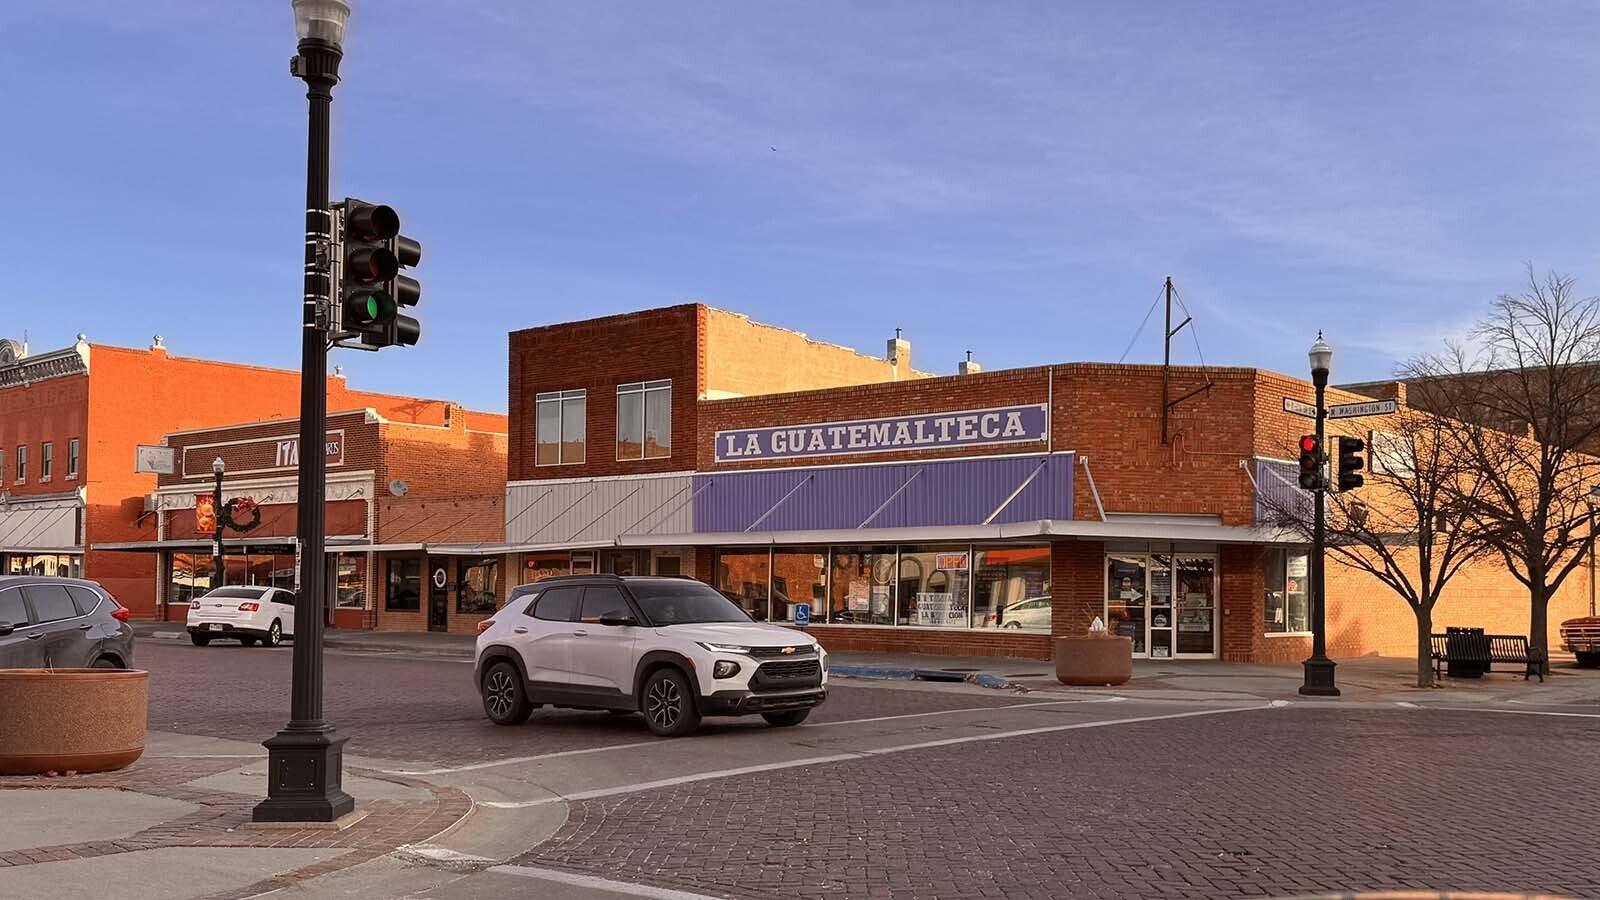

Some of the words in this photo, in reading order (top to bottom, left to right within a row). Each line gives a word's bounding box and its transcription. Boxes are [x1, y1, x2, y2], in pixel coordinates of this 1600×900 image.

[1340, 404, 1380, 415] WASHINGTON
[1384, 402, 1392, 411] ST
[726, 434, 762, 456] LA
[771, 411, 1026, 454] GUATEMALTECA
